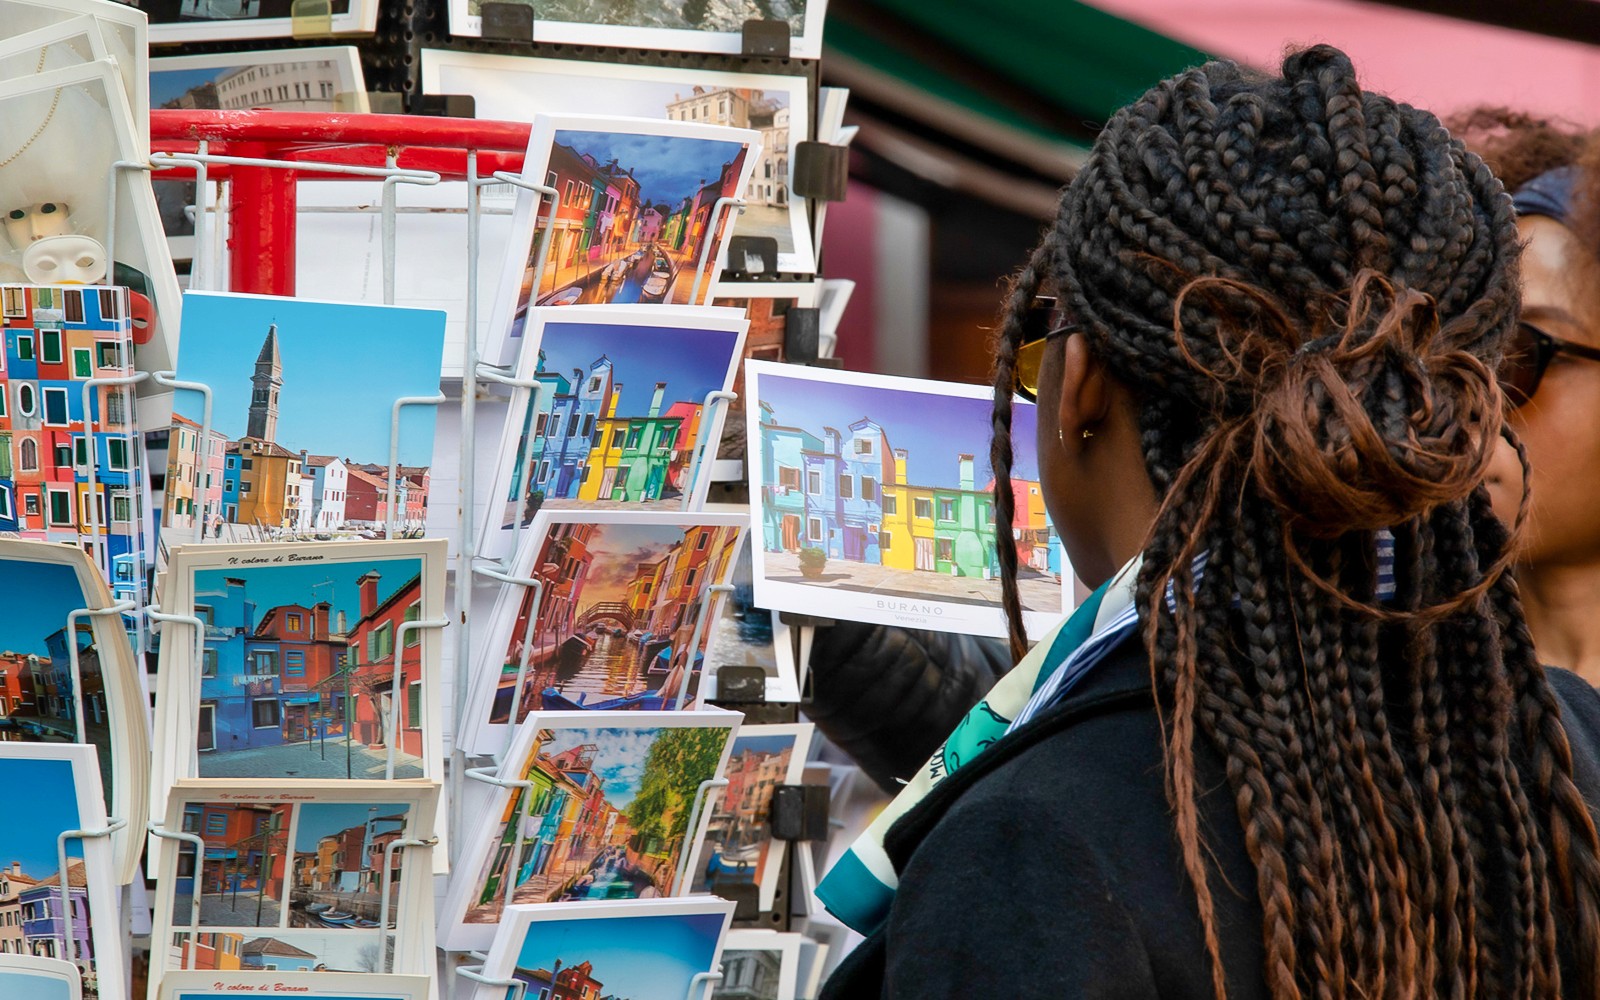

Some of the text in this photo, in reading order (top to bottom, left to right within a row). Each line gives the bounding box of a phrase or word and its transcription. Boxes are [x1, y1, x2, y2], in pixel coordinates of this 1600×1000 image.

[227, 557, 239, 565] Il
[241, 557, 269, 565] colore
[287, 554, 324, 562] Burano
[876, 600, 943, 616] BURANO
[894, 614, 927, 624] Venezia
[213, 982, 225, 991] Il
[227, 983, 254, 991] colore
[273, 982, 309, 992] Burano
